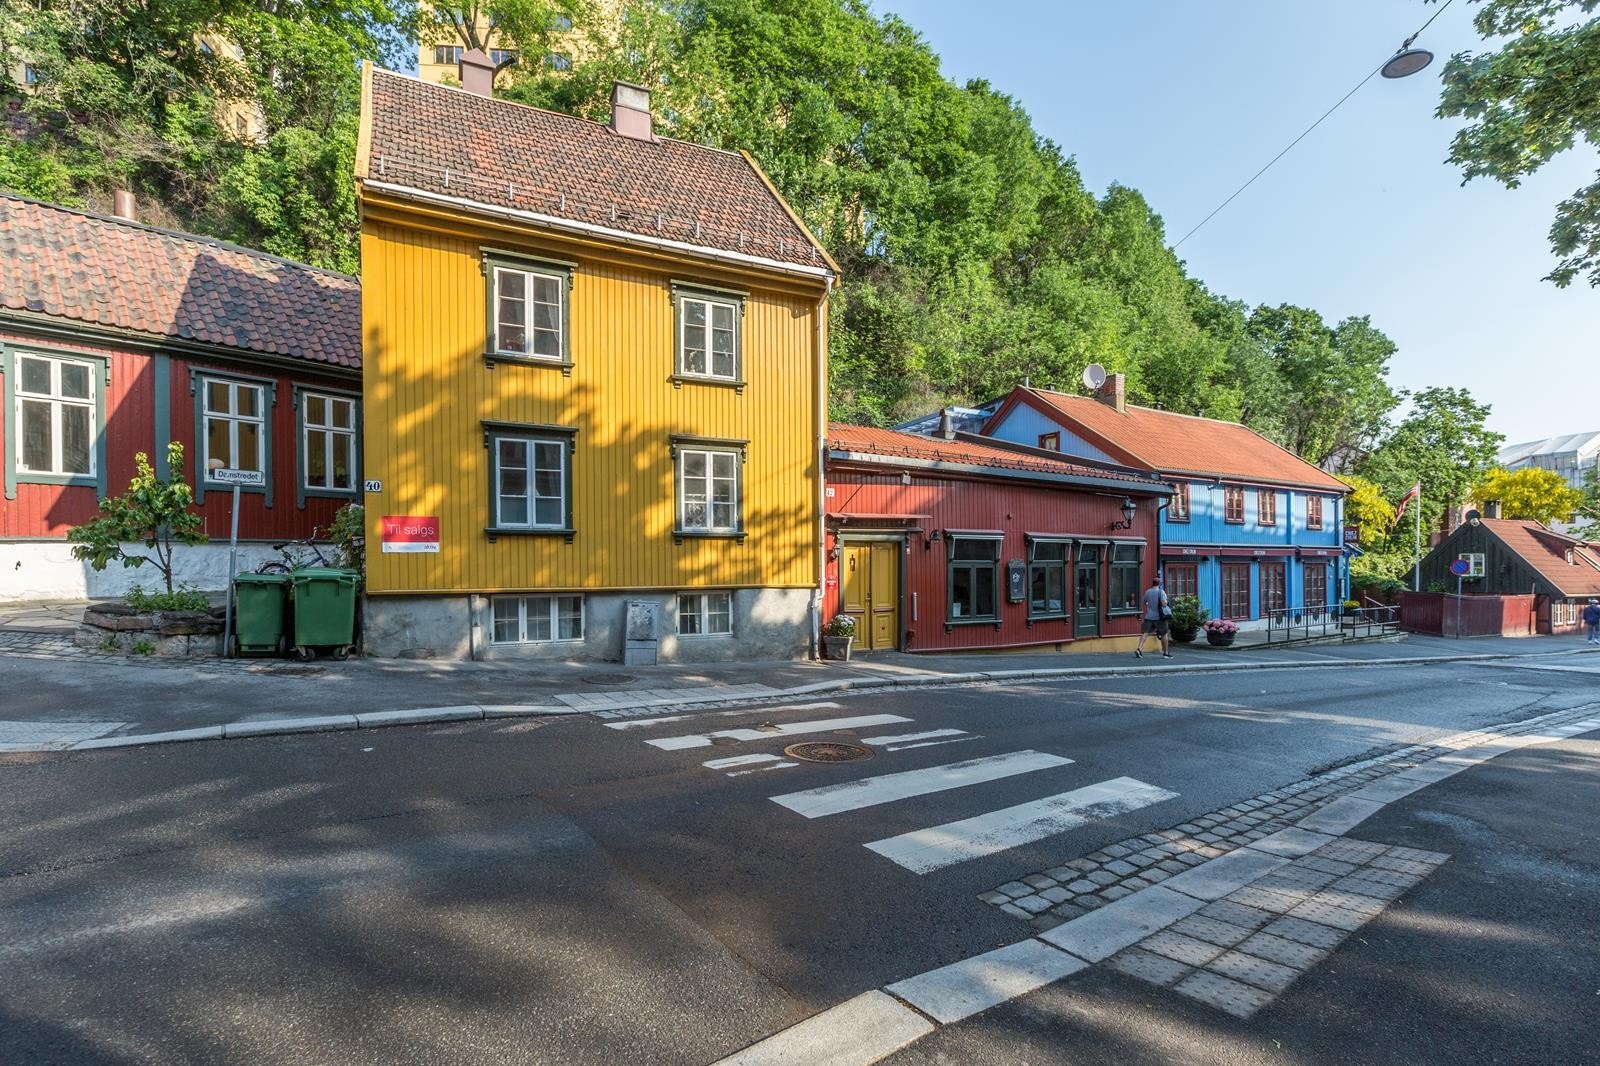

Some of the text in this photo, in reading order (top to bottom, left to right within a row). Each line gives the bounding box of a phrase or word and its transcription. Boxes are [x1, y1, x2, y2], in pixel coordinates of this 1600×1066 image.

[366, 481, 380, 491] 40
[386, 523, 434, 537] Til salgs
